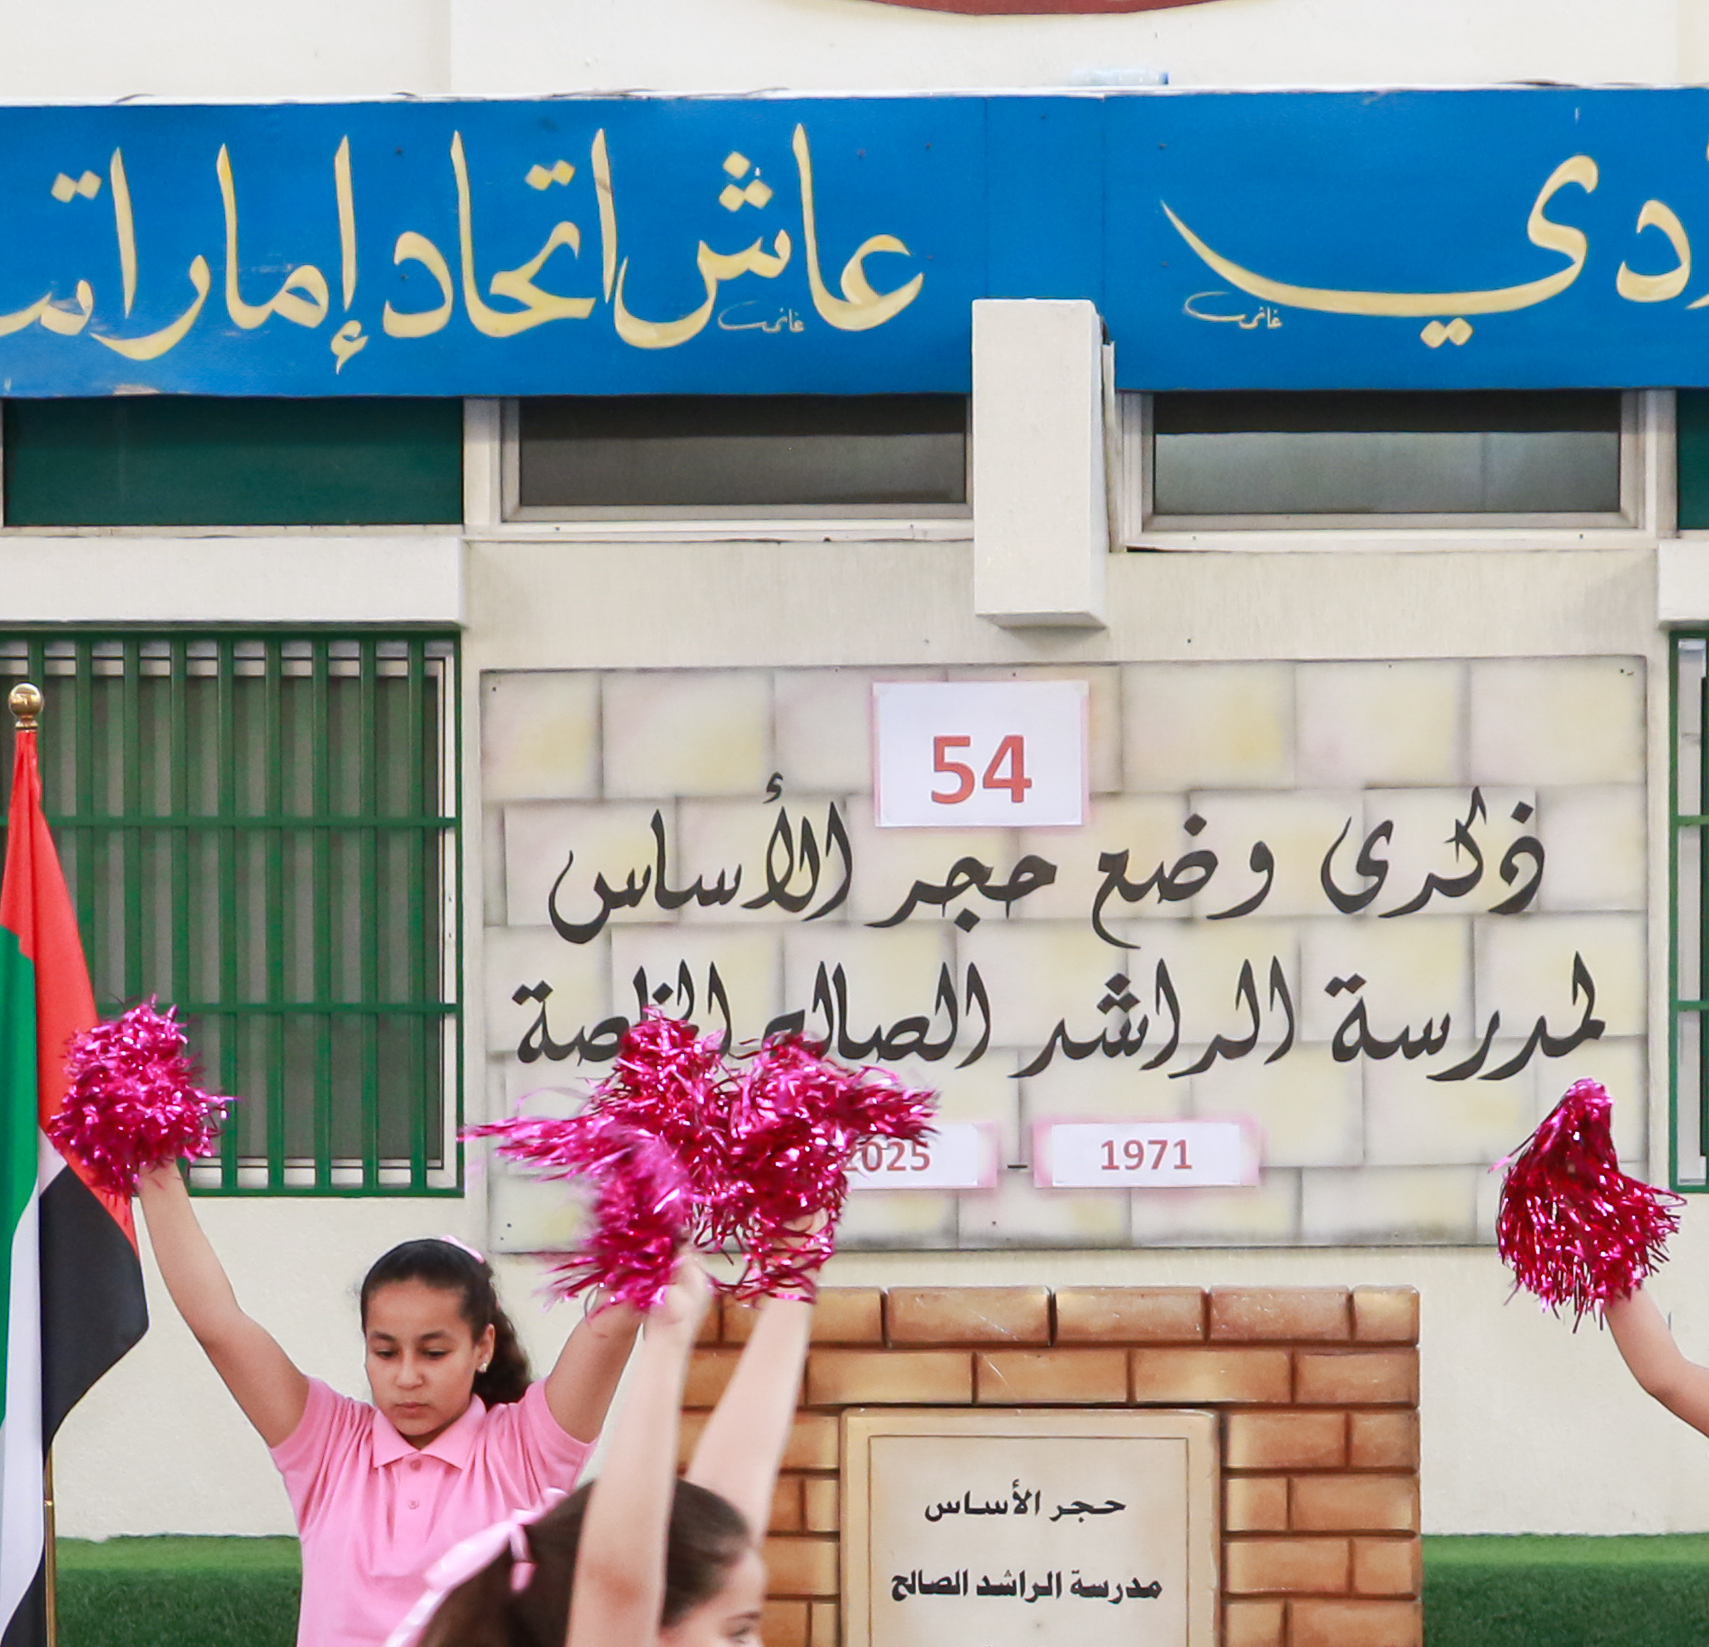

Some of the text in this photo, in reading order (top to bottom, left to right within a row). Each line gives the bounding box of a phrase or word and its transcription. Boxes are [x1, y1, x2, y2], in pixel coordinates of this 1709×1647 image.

[384, 130, 617, 339] اتحاد
[615, 124, 924, 349] عاش
[932, 735, 1033, 805] 54
[548, 772, 853, 945] الأساس
[865, 855, 1057, 933] حجر
[1092, 814, 1274, 950] وضع
[1009, 955, 1295, 1079] الراشد
[1324, 951, 1606, 1082] لمدرسة
[1100, 1139, 1192, 1171] 1971
[924, 1478, 1127, 1523] حجر الأساس
[891, 1569, 1163, 1605] مدرسة الراشد الصالح
